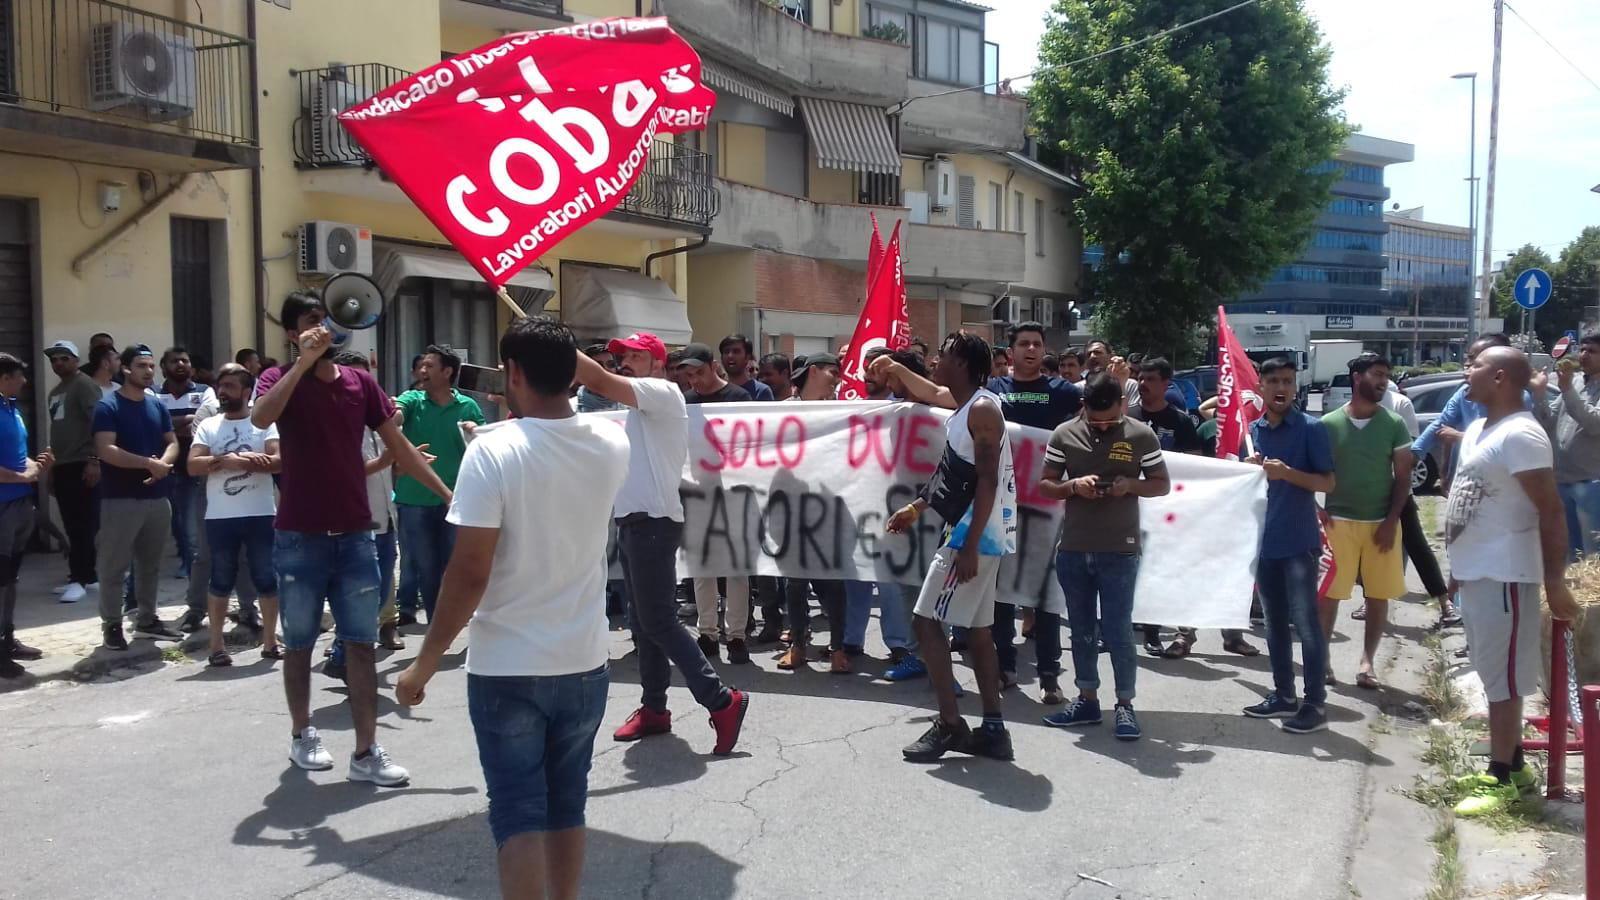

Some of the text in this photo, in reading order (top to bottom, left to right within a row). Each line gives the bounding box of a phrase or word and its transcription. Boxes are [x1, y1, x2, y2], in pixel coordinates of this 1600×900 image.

[481, 186, 596, 277] Lavoratori
[699, 414, 940, 475] SOLO DUE
